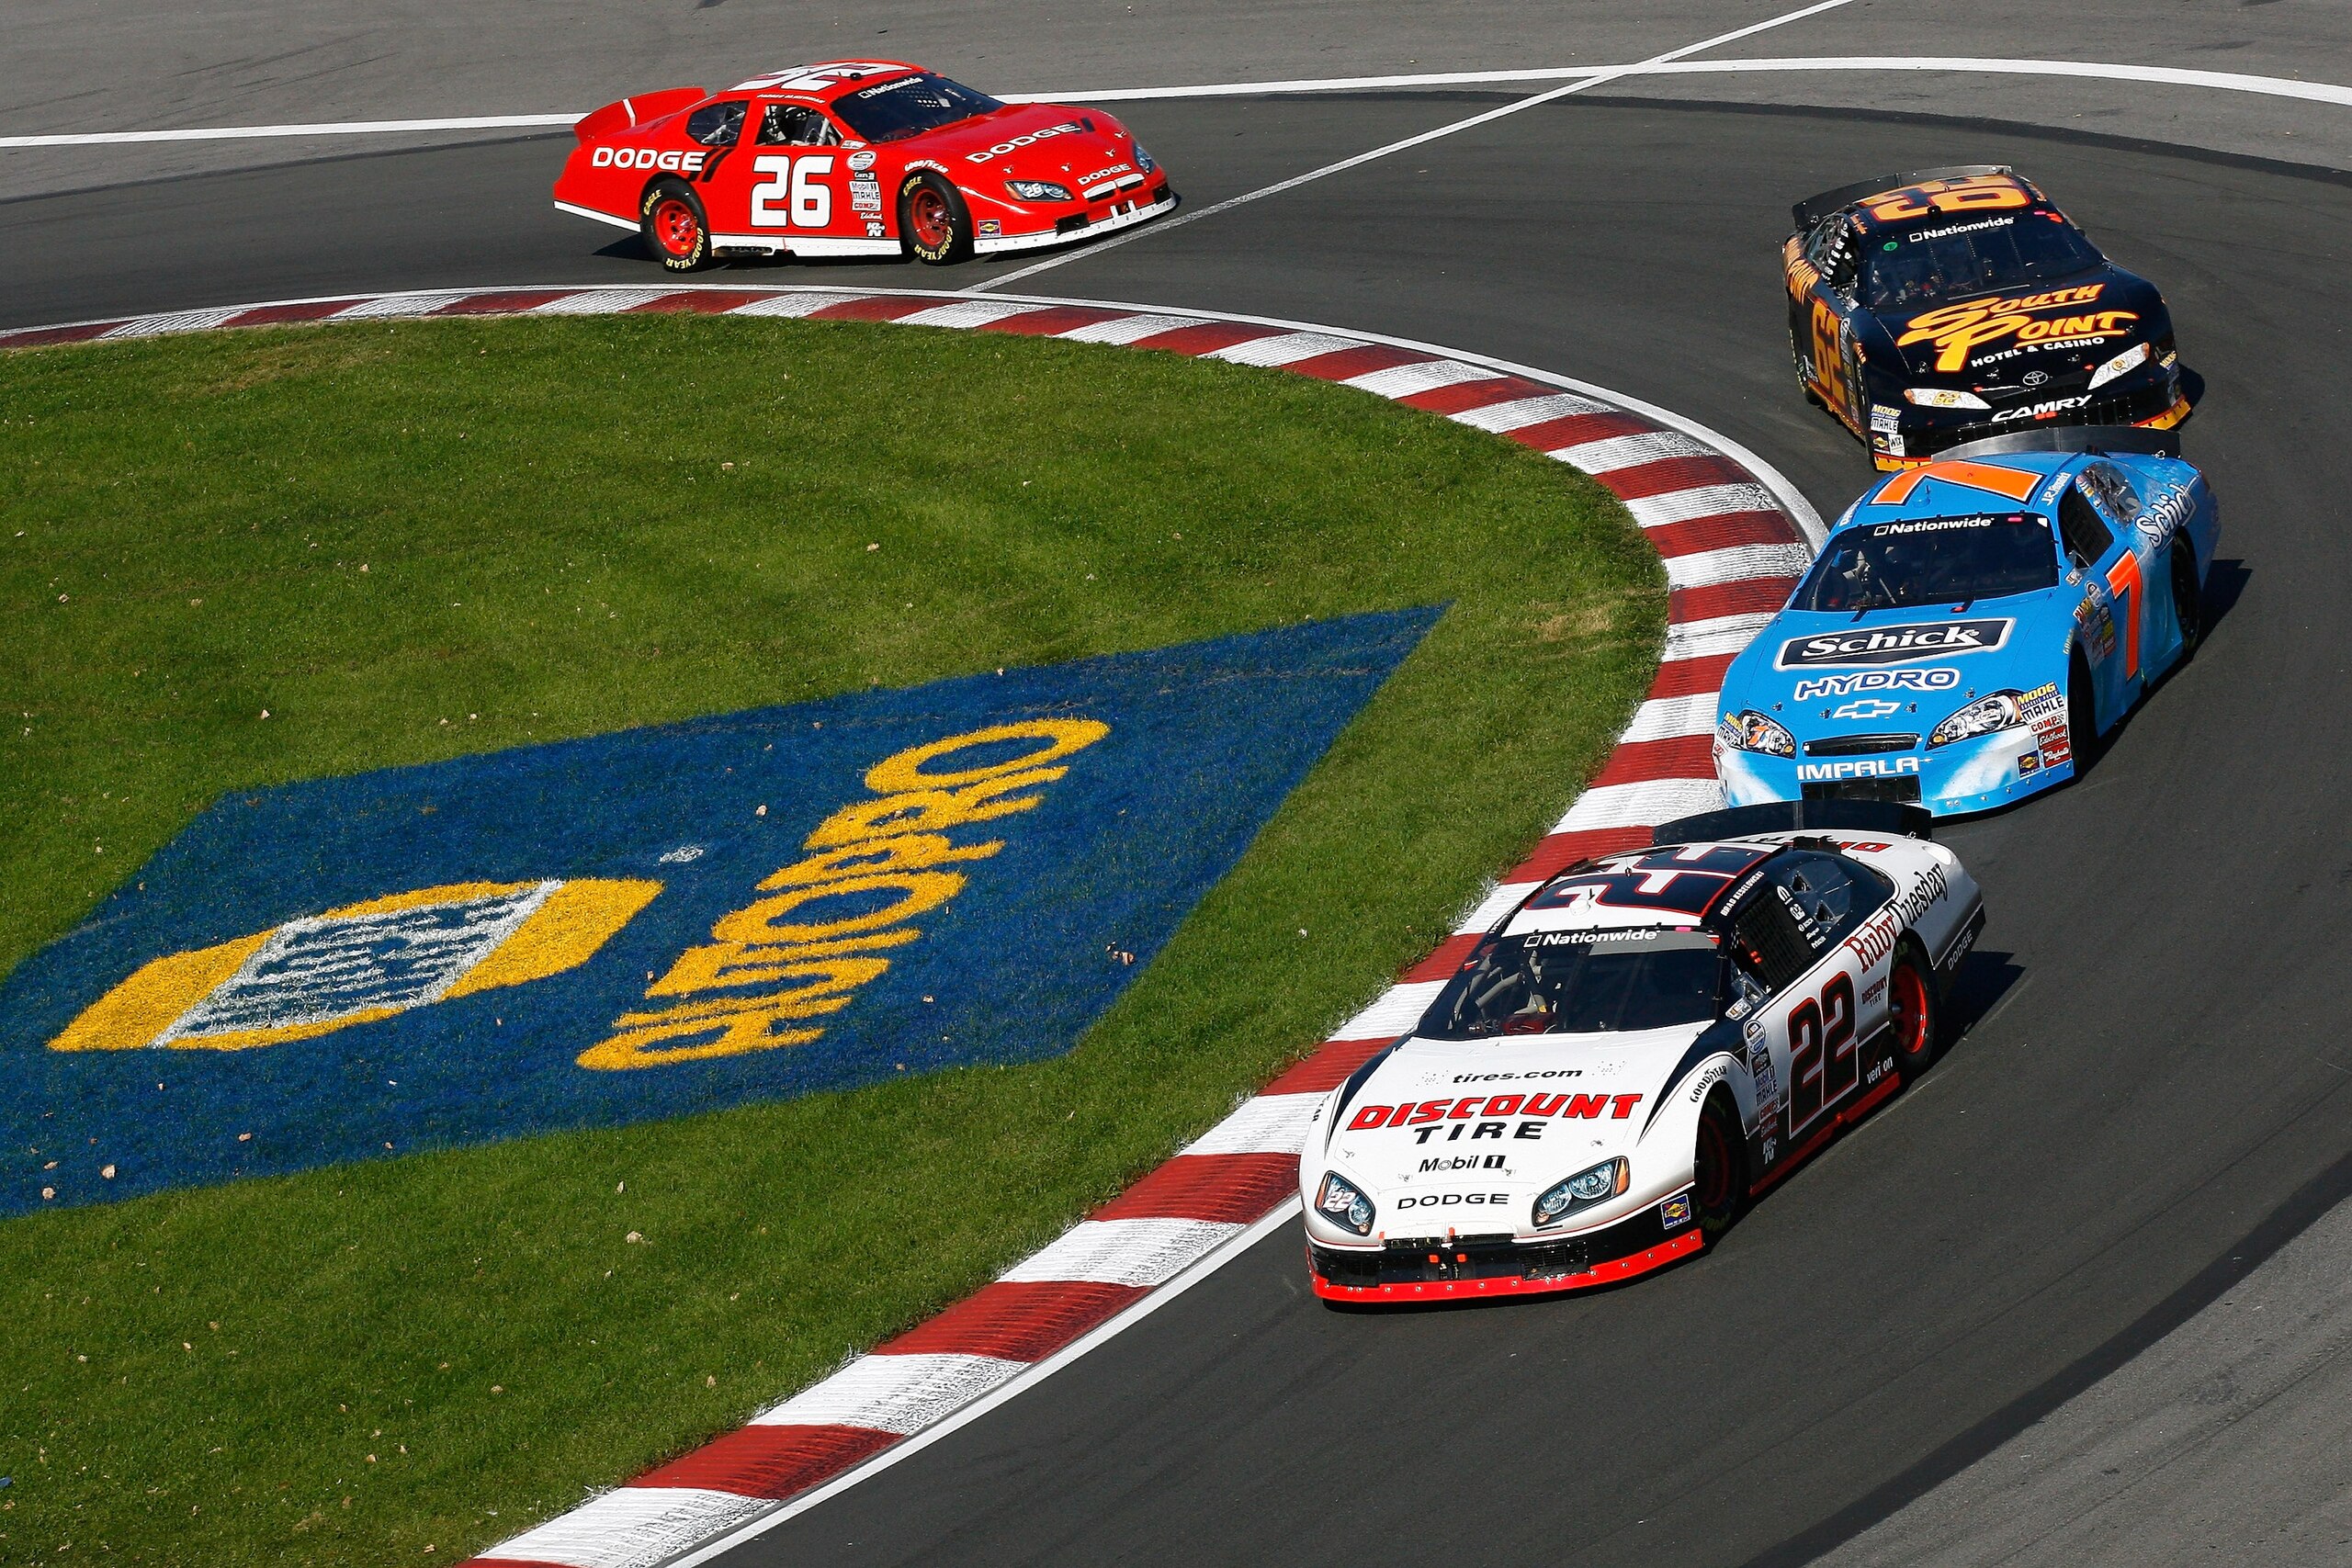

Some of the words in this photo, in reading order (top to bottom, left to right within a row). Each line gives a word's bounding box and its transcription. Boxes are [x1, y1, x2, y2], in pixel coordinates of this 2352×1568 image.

[871, 77, 923, 96] Nationwide
[966, 122, 1081, 164] DODGE
[592, 147, 707, 172] DODGE
[904, 159, 950, 174] GOODYEAR
[1077, 164, 1132, 186] DODGE
[643, 189, 662, 216] EAGLE
[751, 155, 834, 228] 26
[853, 191, 880, 200] MAHLE
[1024, 183, 1044, 197] 26
[1924, 217, 2012, 240] Nationwide
[665, 227, 704, 269] GOODYEAR
[914, 226, 954, 260] GOODYEAR
[1896, 283, 2106, 348] SOUTH
[1811, 297, 1847, 407] 62
[1935, 310, 2140, 372] POINT
[1971, 349, 2023, 367] HOTEL
[2027, 344, 2039, 353] &
[2043, 337, 2105, 351] CASINO
[1871, 404, 1902, 417] MOOG
[1931, 391, 1960, 406] 62
[1991, 394, 2093, 423] CAMRY
[1871, 419, 1898, 432] MAHLE
[1889, 435, 1903, 448] WIX
[1889, 516, 1993, 535] Nationwide
[2105, 548, 2143, 682] 7
[1802, 626, 1983, 660] Schick
[1794, 669, 1960, 701] HYDRO
[2017, 682, 2056, 705] MOOG
[2021, 695, 2064, 721] MAHLE
[1747, 725, 1770, 746] 7
[2031, 716, 2058, 732] COMP
[1796, 756, 1920, 780] IMPALA
[575, 717, 1112, 1071] AUTOPRO
[1720, 897, 1737, 917] BRAD
[1735, 870, 1764, 901] KESELOWSKI
[1843, 915, 1898, 974] Ruby
[1883, 863, 1948, 929] Tuesday
[1543, 929, 1660, 947] Nationwide
[1948, 930, 1973, 971] DODGE
[1861, 976, 1888, 1005] DISCOUNT
[1869, 993, 1882, 1008] TIRE
[1788, 970, 1859, 1139] 22
[1453, 1068, 1582, 1084] tires.com
[1690, 1065, 1727, 1103] GOODYEAR
[1756, 1079, 1778, 1106] MAHLE
[1346, 1093, 1643, 1131] DISCOUNT
[1414, 1122, 1547, 1145] TIRE
[1419, 1155, 1480, 1173] Mobil
[1483, 1155, 1507, 1168] 1
[1323, 1190, 1357, 1213] 22
[1397, 1193, 1510, 1211] DODGE
